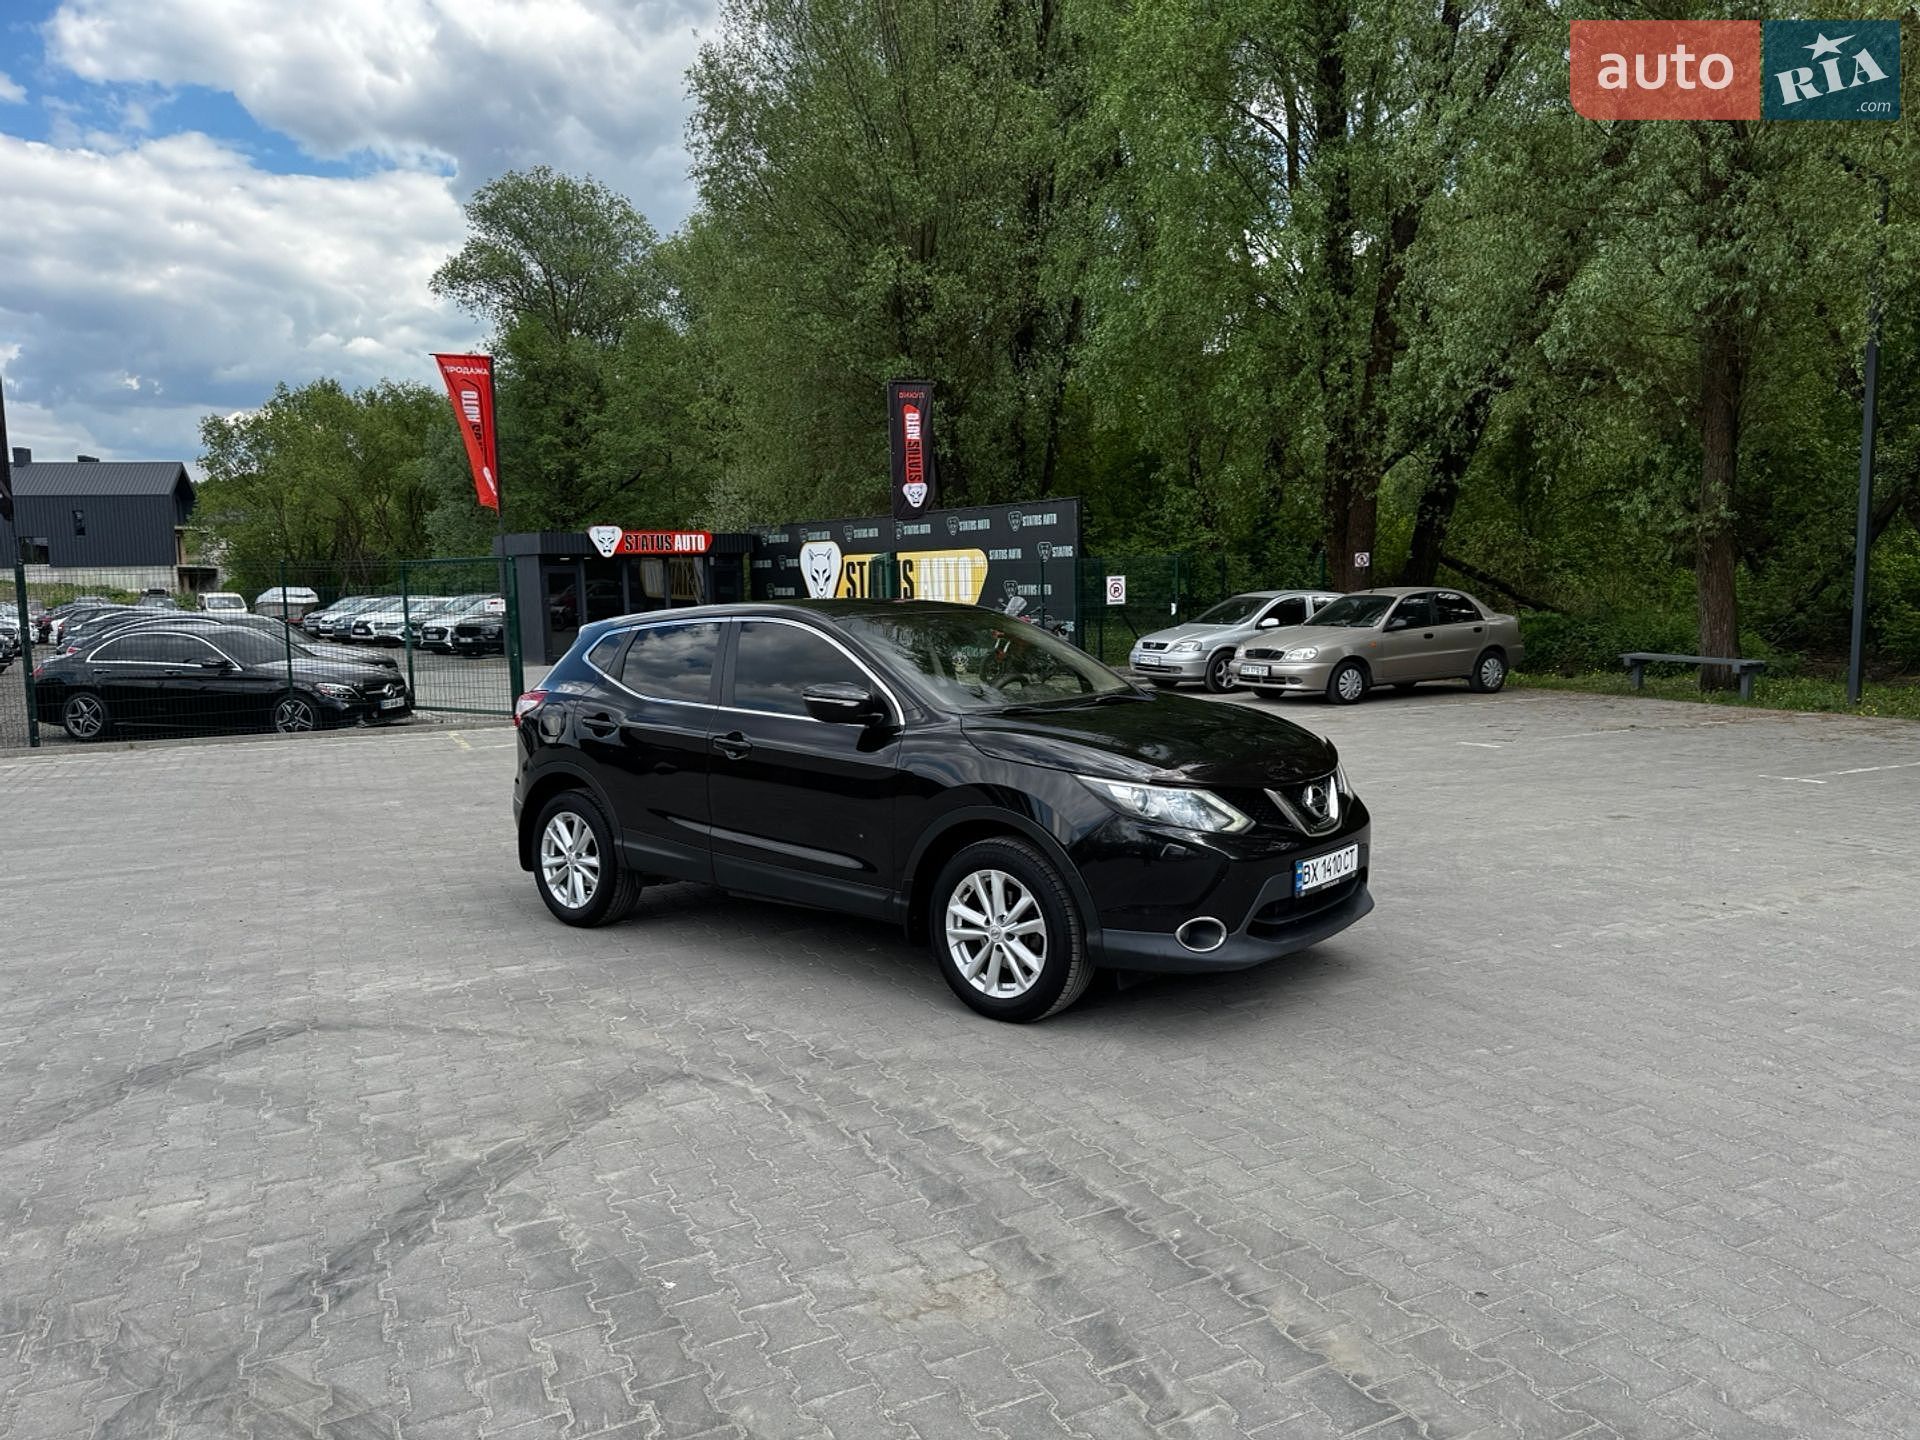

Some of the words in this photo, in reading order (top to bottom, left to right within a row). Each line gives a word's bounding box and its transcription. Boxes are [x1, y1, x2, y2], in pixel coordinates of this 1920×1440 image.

[905, 413, 921, 440] AUTO
[908, 441, 922, 482] STATUS
[1022, 515, 1042, 526] STATUS
[625, 534, 673, 551] STATUS
[674, 534, 705, 551] AUTO
[1052, 546, 1073, 557] STATUS
[919, 556, 972, 603] AUTO
